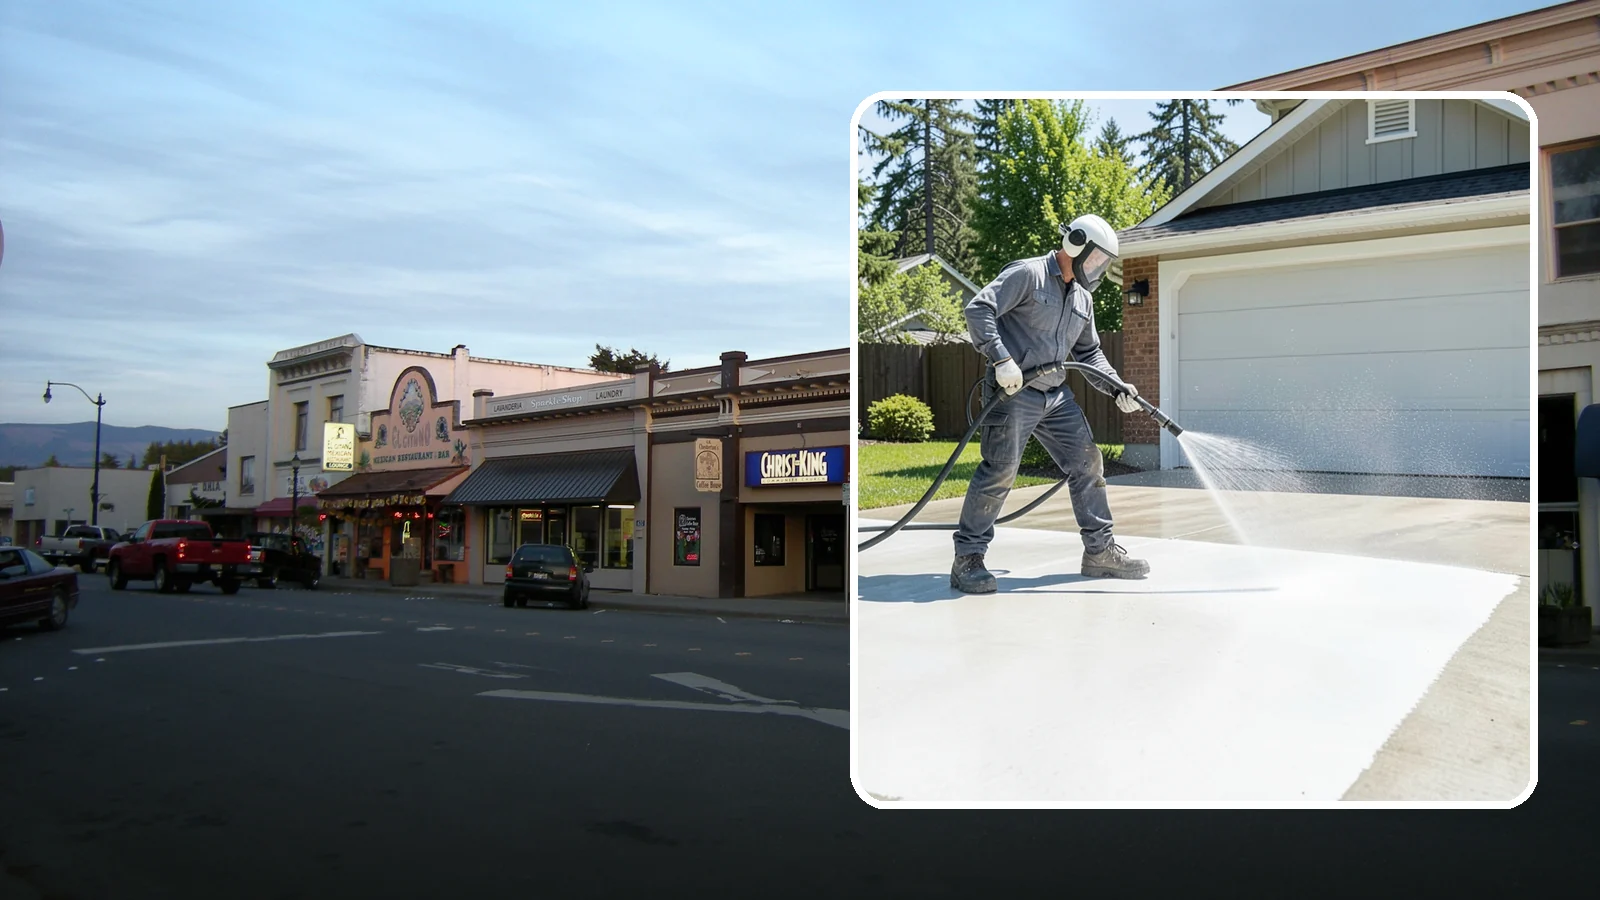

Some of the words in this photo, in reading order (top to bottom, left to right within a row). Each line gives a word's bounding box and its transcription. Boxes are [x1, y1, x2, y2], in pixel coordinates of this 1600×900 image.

[493, 402, 523, 413] LAVANDERIA
[531, 396, 561, 409] Sparkle
[562, 394, 582, 405] Shop
[595, 389, 624, 400] LAUNDRY
[373, 456, 396, 464] MEXICAN
[397, 452, 433, 463] RESTAURANT
[437, 451, 450, 459] BAR
[761, 452, 797, 477] CHRIST
[799, 450, 828, 476] KING
